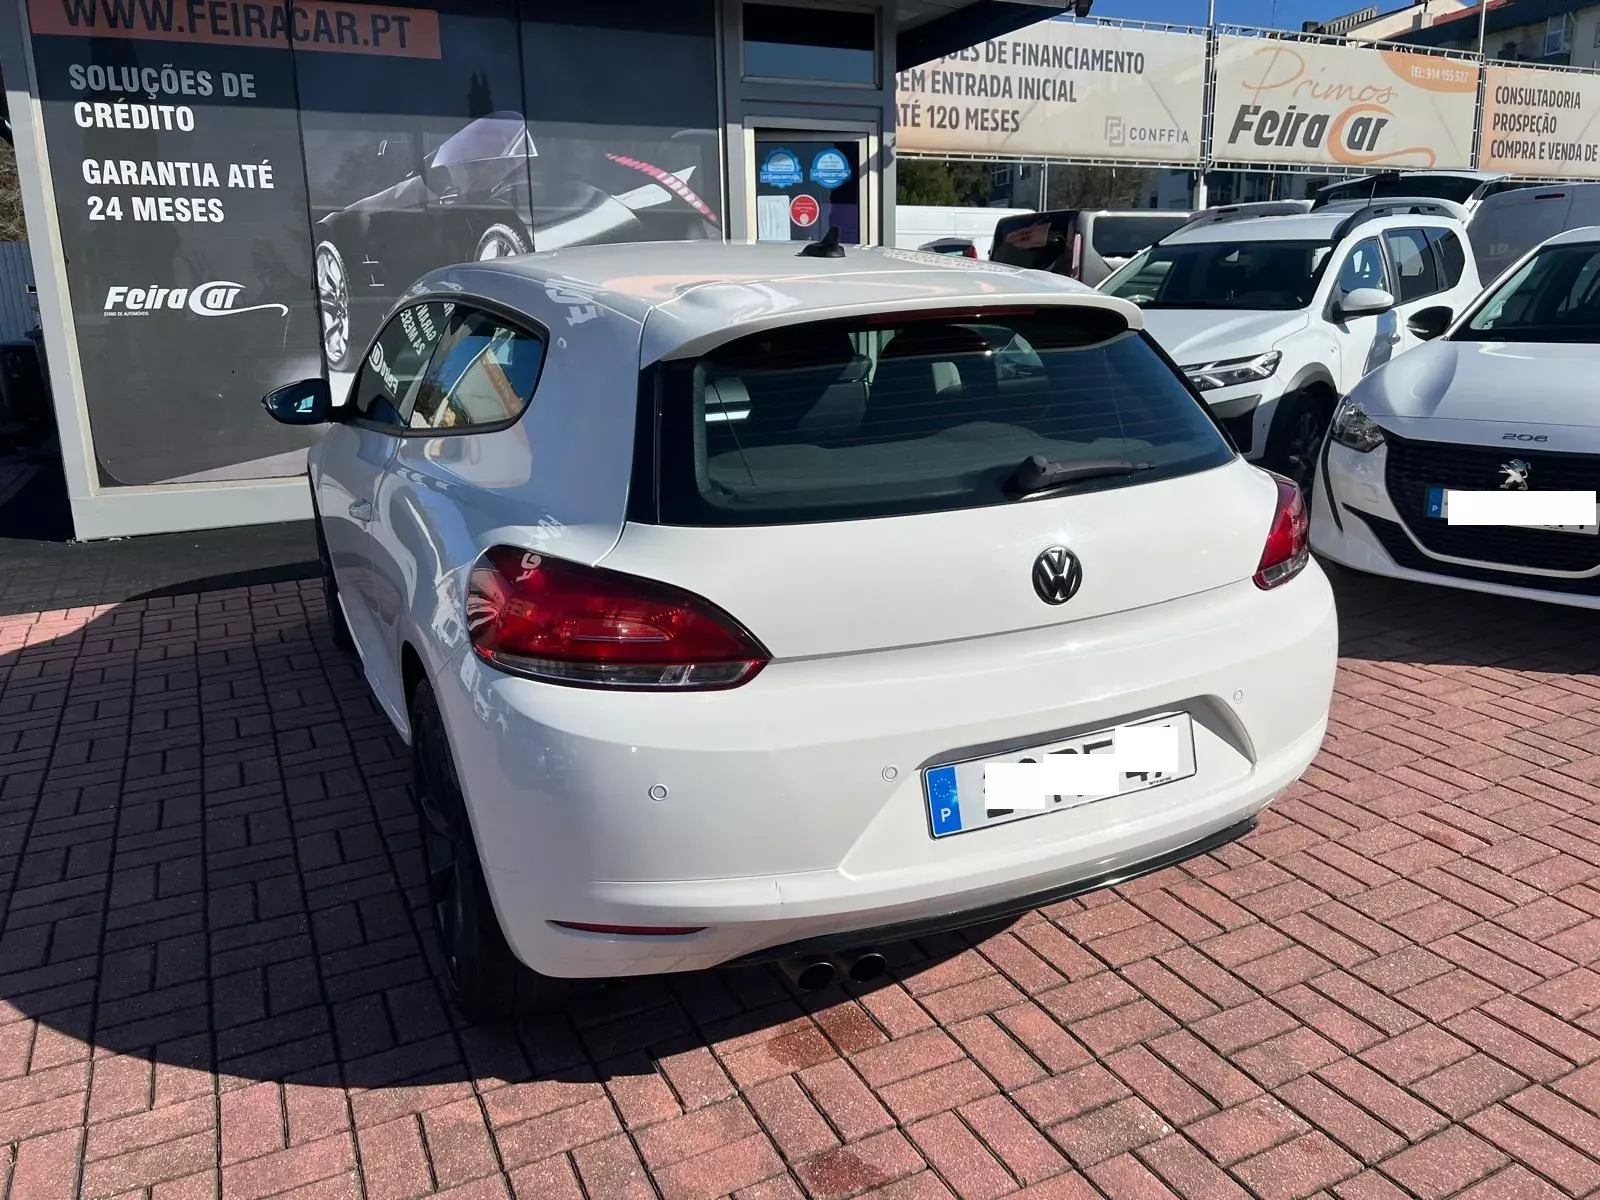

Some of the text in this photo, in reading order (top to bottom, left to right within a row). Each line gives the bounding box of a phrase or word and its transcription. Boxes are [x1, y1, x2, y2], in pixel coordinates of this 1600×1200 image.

[61, 0, 411, 49] WWW.FEIRACAR.PT
[985, 41, 1007, 64] DE
[1011, 42, 1145, 75] FINANCIAMENTO
[69, 63, 257, 100] SOLUÇÕES DE
[931, 70, 1013, 99] ENTRADA
[1018, 76, 1077, 103] INICIAL
[1241, 46, 1398, 106] Primos
[1495, 85, 1581, 109] CONSULTADORIA
[74, 97, 195, 132] CRÉDITO
[926, 105, 960, 130] 120
[965, 107, 1020, 133] MESES
[1492, 112, 1557, 137] PROSPEÇÃO
[1130, 127, 1190, 143] CONFFIA
[1228, 103, 1436, 167] FeiraCar
[1490, 139, 1598, 162] COMPRA E VENDA DE
[82, 158, 275, 189] GARANTIA ATÉ
[87, 196, 225, 223] 24 MESES
[103, 280, 289, 317] FeiraCar
[940, 807, 952, 823] P
